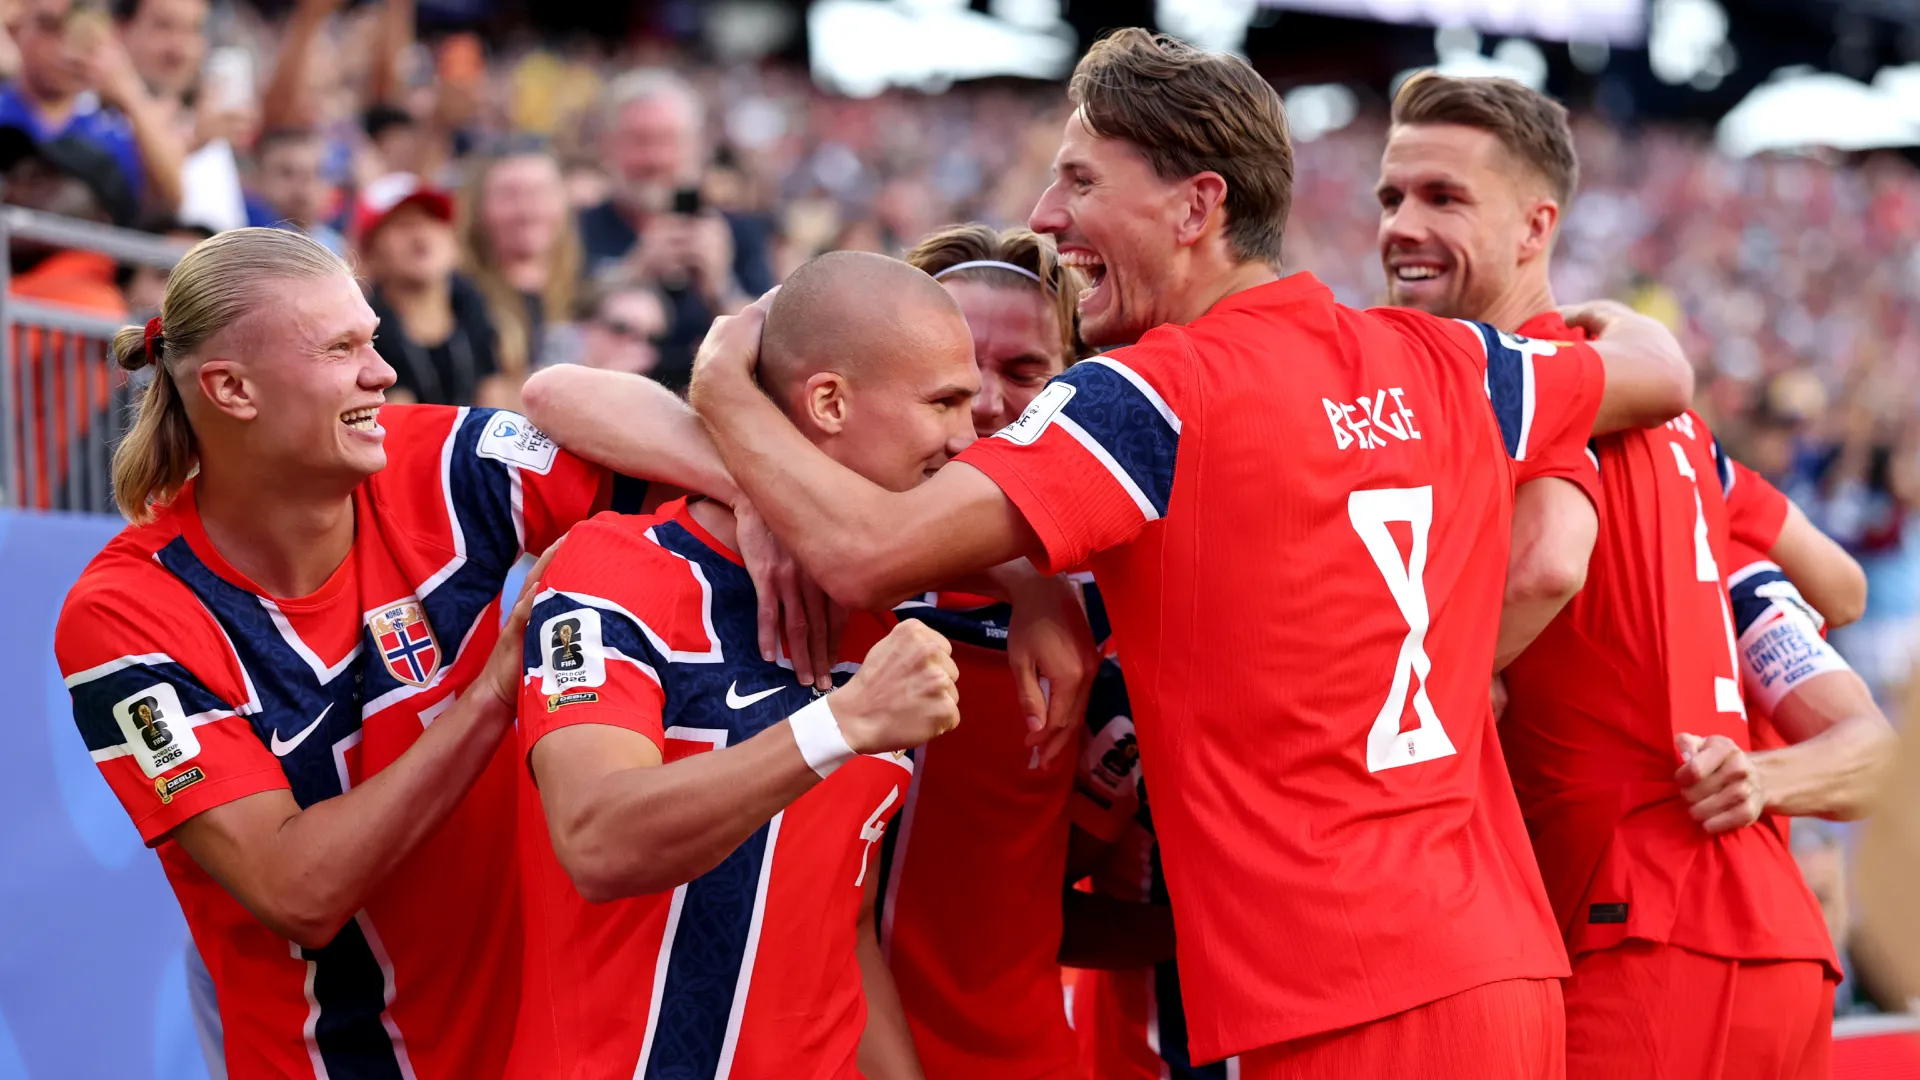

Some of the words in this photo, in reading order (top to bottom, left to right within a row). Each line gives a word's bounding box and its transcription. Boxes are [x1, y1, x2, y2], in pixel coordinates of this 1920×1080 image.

[385, 608, 403, 620] NORGE
[1348, 485, 1457, 773] 8
[1751, 636, 1811, 674] UNITES
[153, 736, 166, 746] FIFA
[152, 747, 169, 760] WORLD
[167, 743, 179, 753] CUP
[154, 749, 182, 768] 2026
[167, 770, 197, 788] DEBUT
